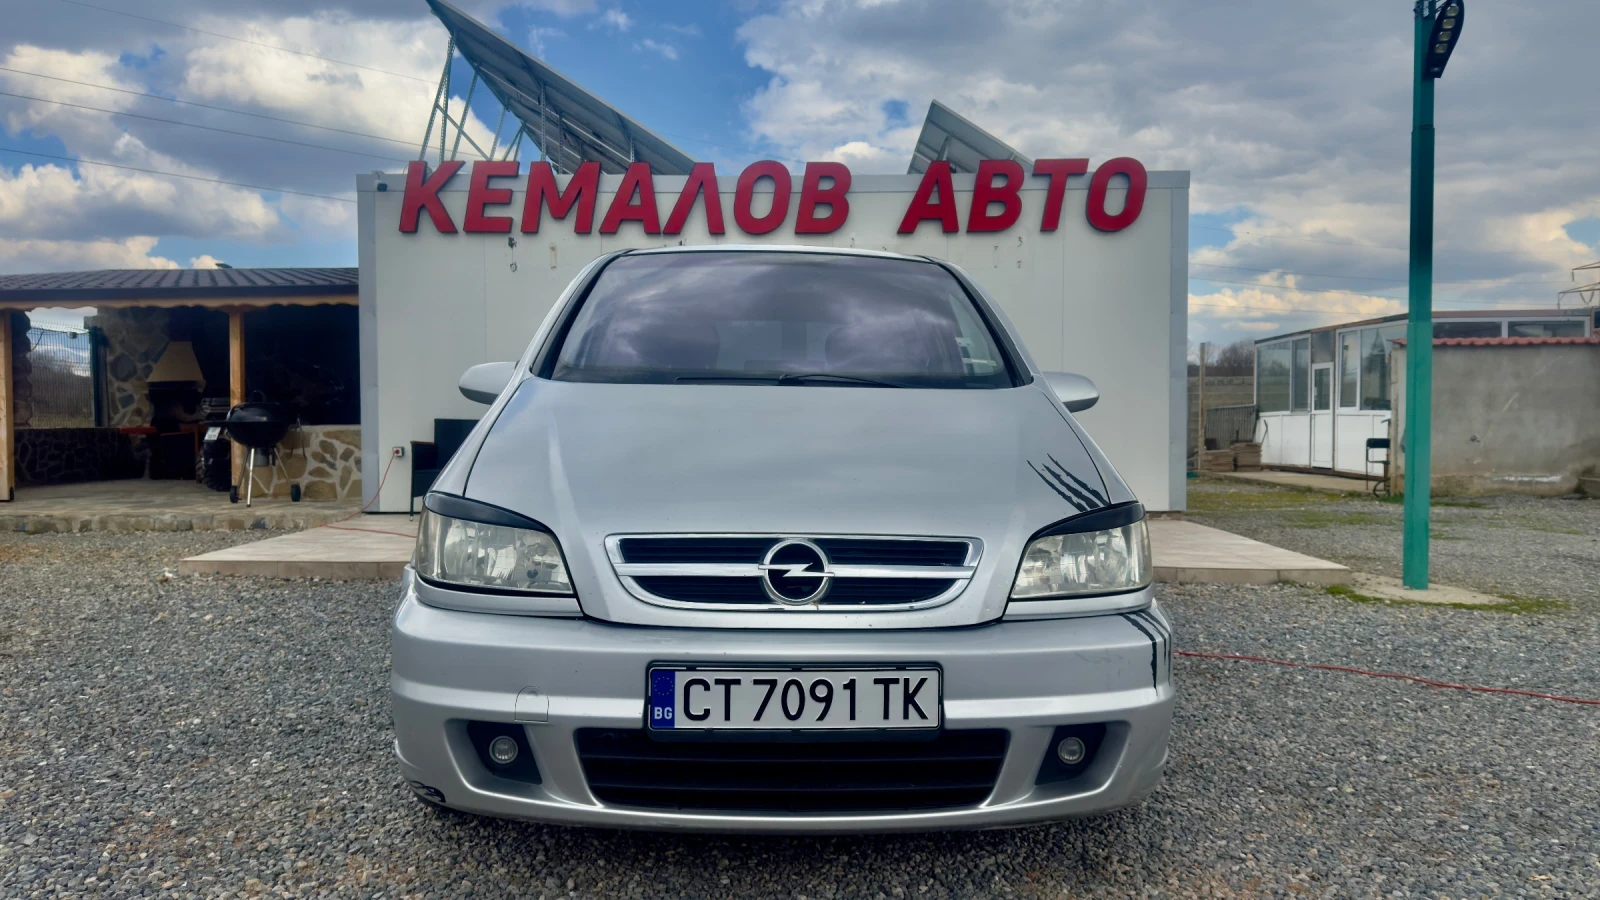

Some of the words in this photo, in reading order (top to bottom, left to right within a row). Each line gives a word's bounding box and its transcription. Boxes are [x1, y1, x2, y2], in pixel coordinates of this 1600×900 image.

[399, 160, 852, 235] КЕМАЛОВ
[897, 156, 1148, 234] АВТО
[653, 706, 673, 720] BG
[752, 678, 857, 721] 7091
